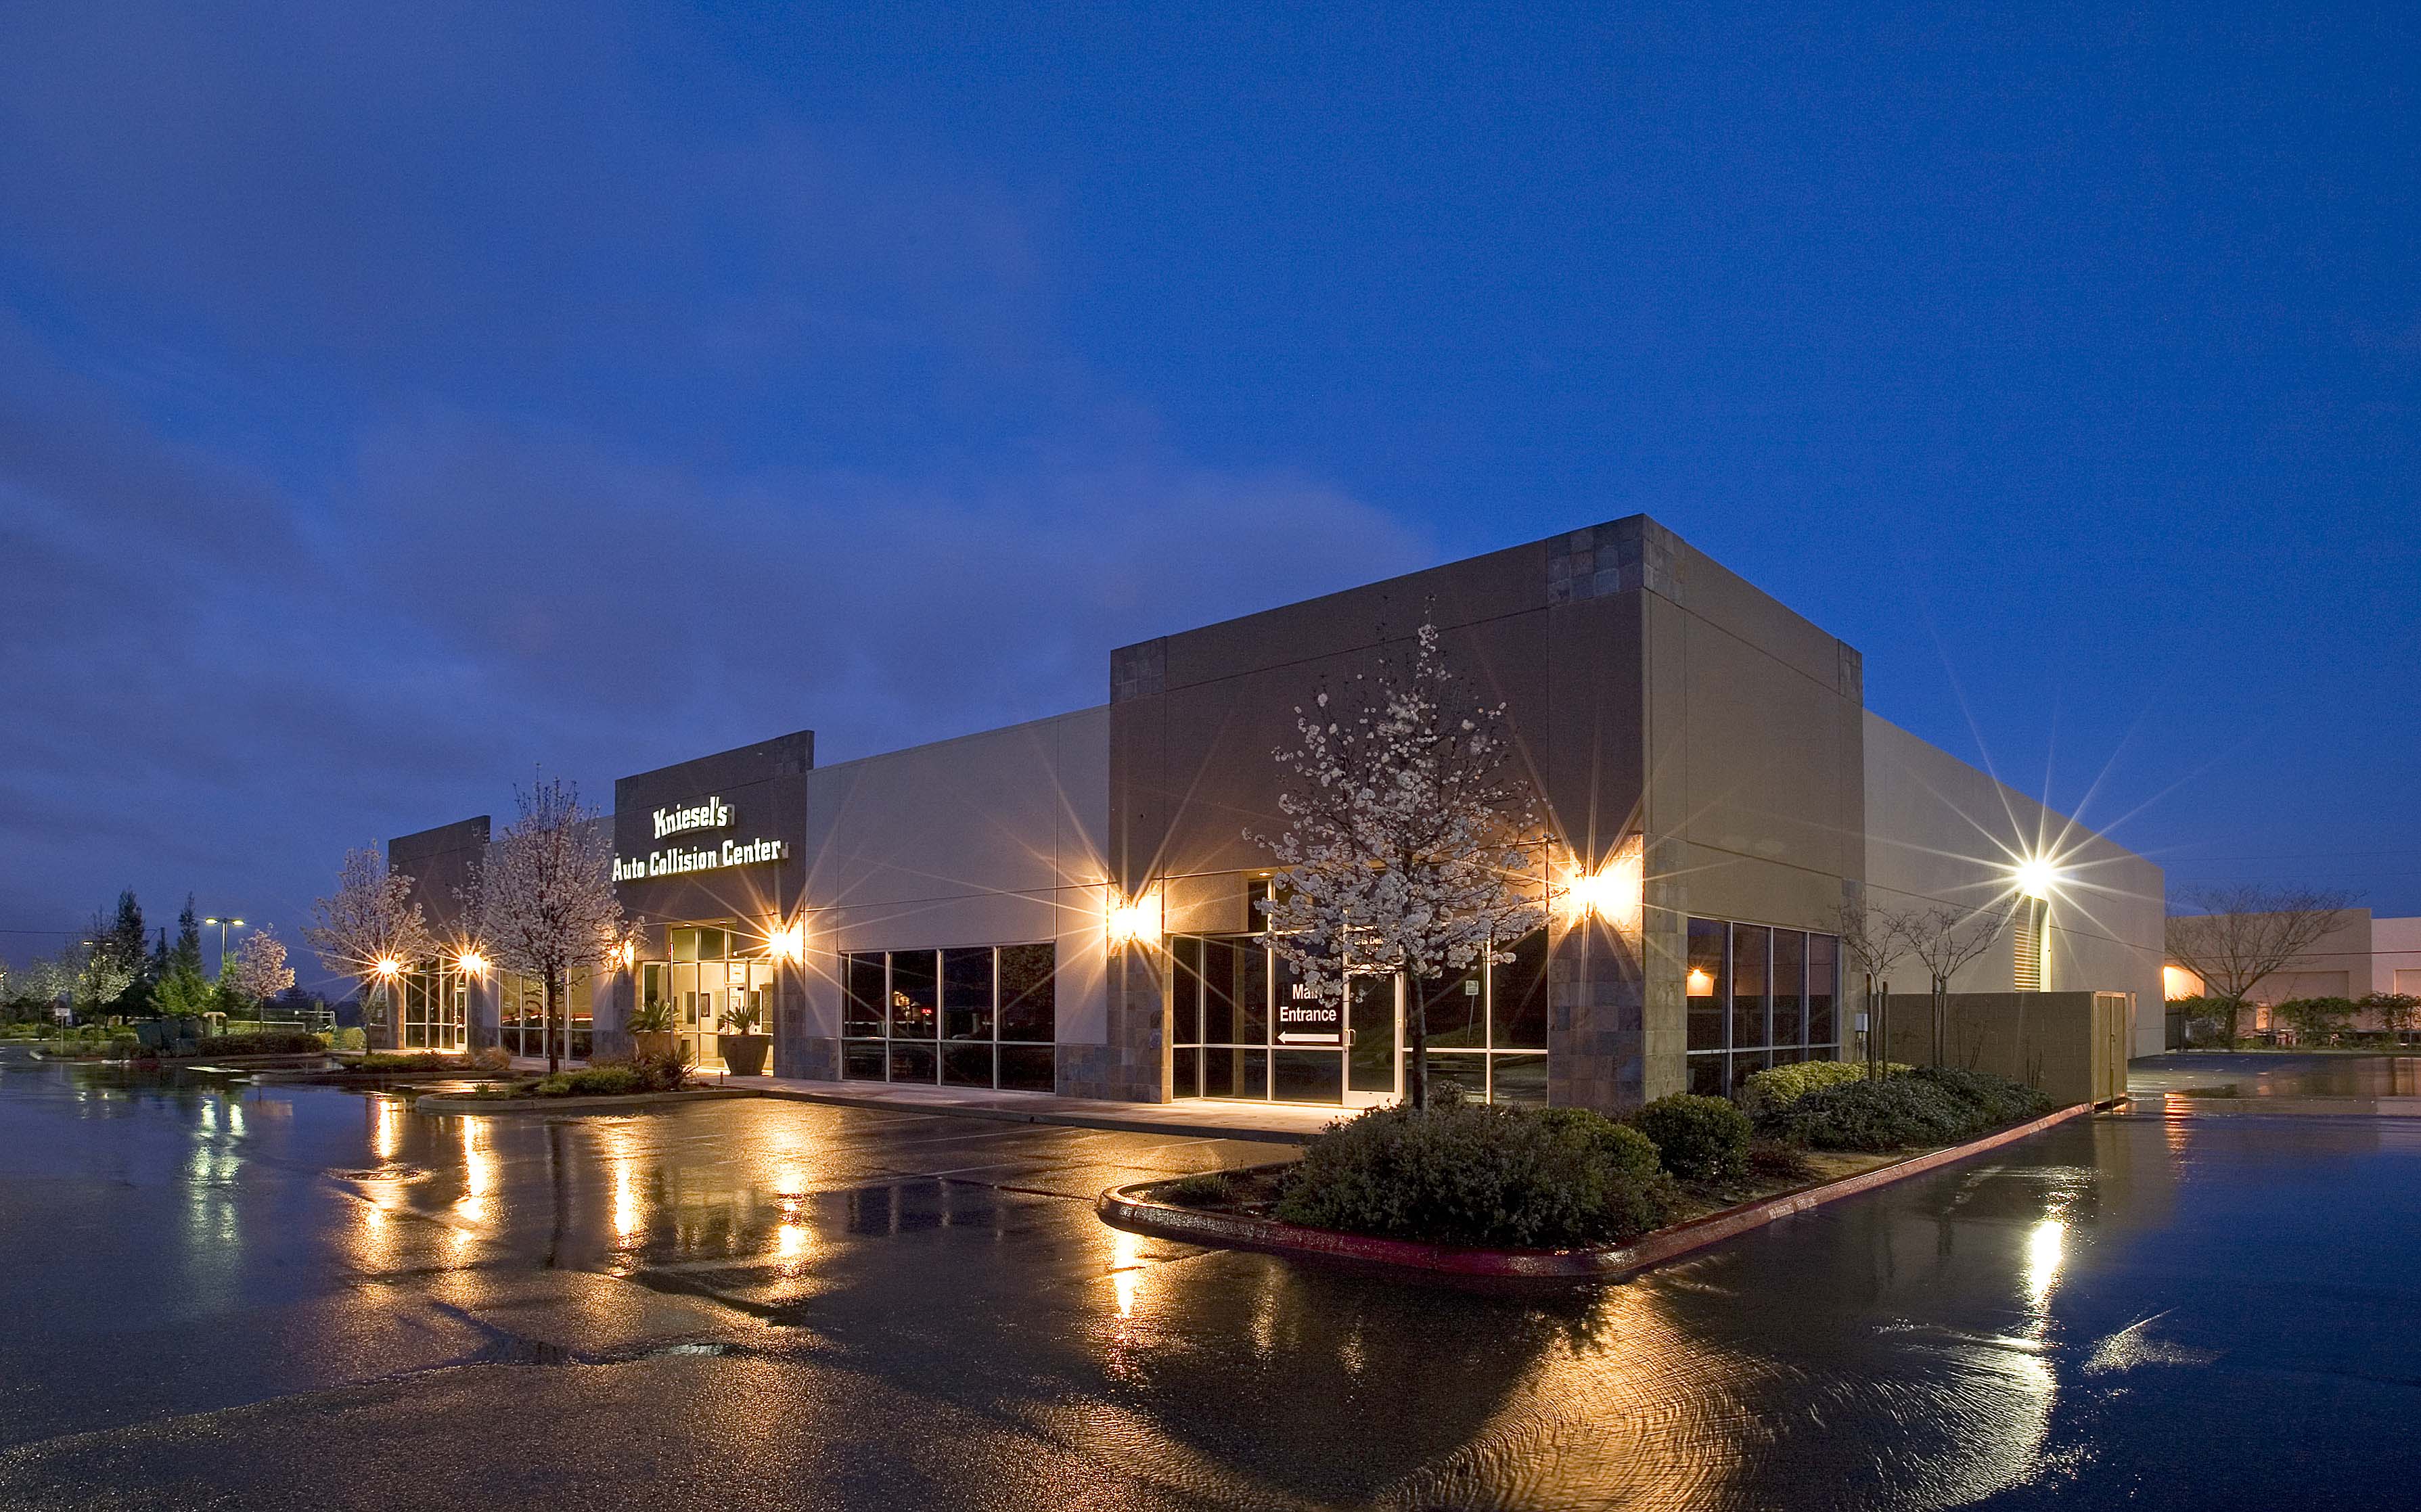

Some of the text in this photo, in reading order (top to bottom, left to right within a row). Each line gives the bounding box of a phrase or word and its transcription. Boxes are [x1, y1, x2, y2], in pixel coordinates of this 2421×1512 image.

[652, 796, 728, 840] Kniesel's
[612, 838, 782, 882] Auto Collision Center
[1280, 1006, 1337, 1022] Entrance
